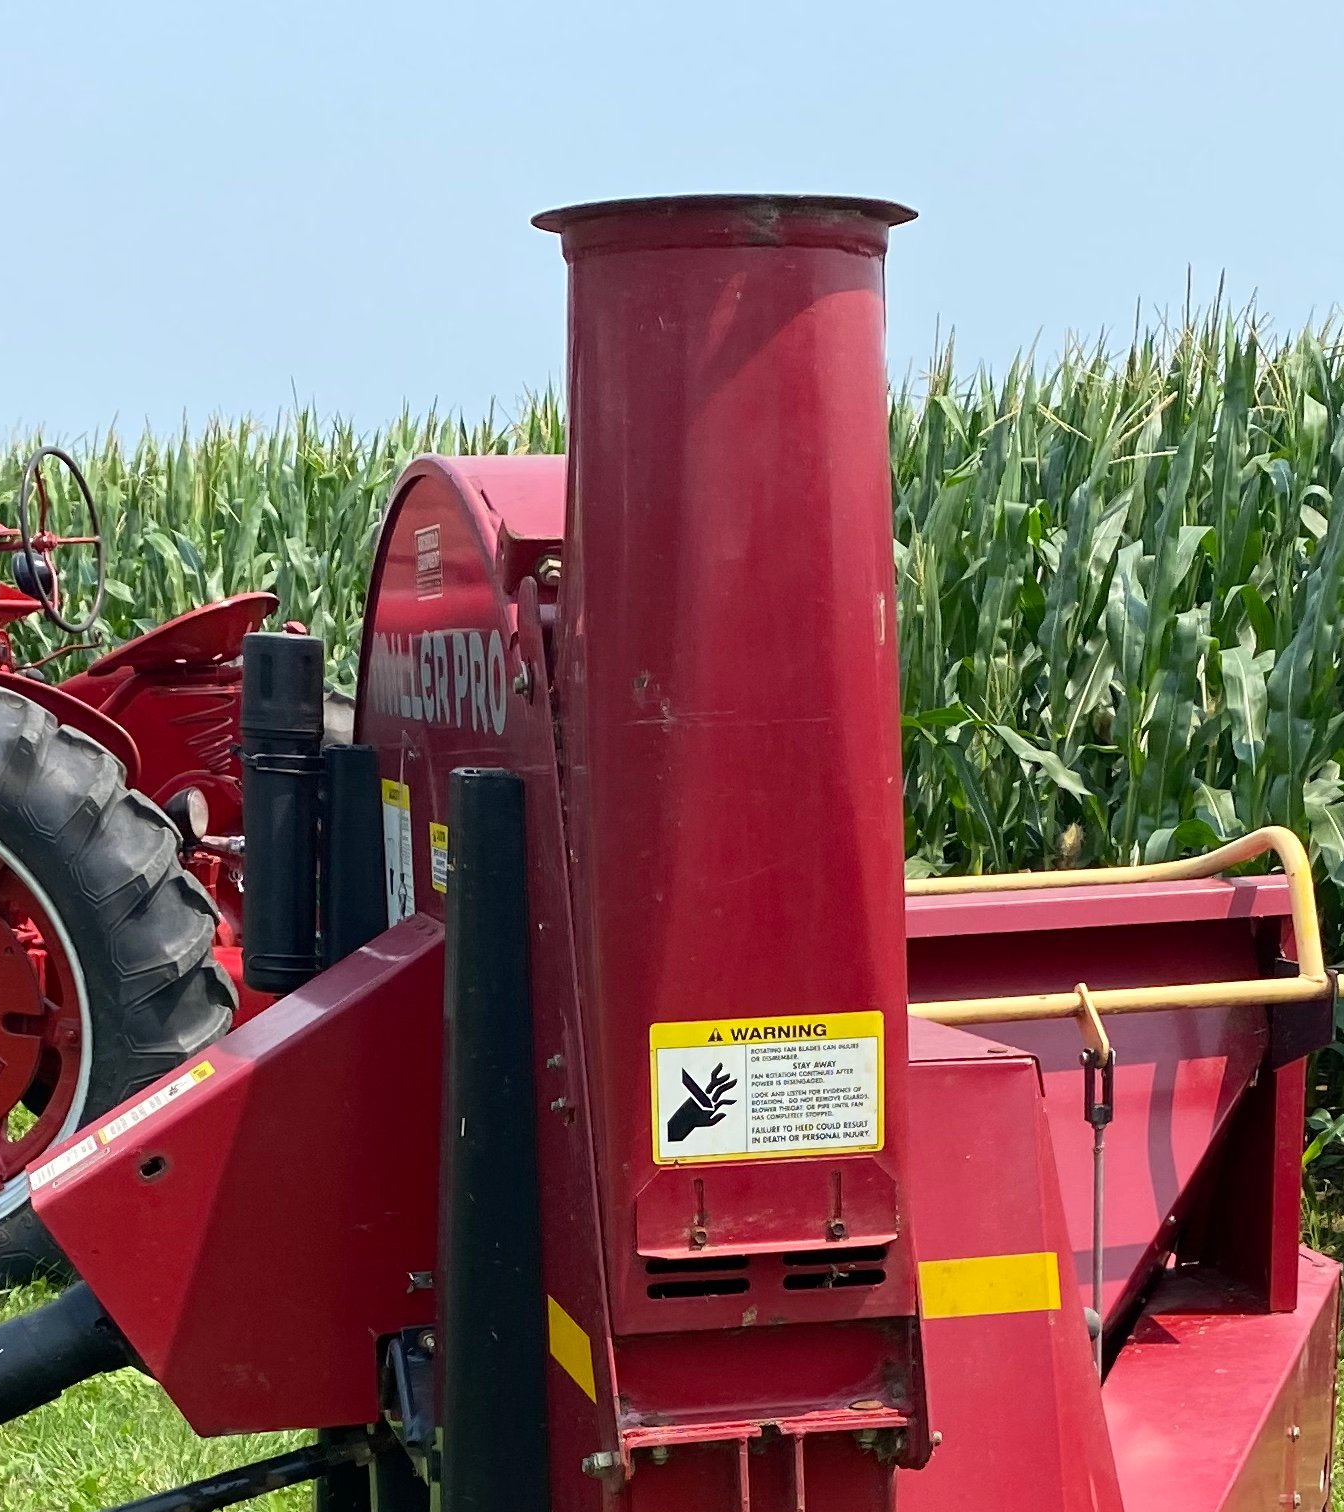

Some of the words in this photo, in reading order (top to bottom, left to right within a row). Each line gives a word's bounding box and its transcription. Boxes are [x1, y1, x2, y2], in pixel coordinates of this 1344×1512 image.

[453, 629, 506, 735] PRO
[730, 1023, 827, 1042] WARNING
[792, 1062, 811, 1070] STAY
[813, 1060, 836, 1069] AWAY
[751, 1091, 768, 1099] LOOK
[771, 1090, 785, 1098] AND
[752, 1125, 780, 1134] FAILURE
[782, 1124, 792, 1132] TO
[795, 1123, 814, 1131] HEED
[816, 1122, 841, 1130] COULD
[843, 1120, 868, 1129] RESULT
[763, 1135, 786, 1143] DEATH
[789, 1134, 799, 1142] OR
[802, 1132, 841, 1141] PERSONAL
